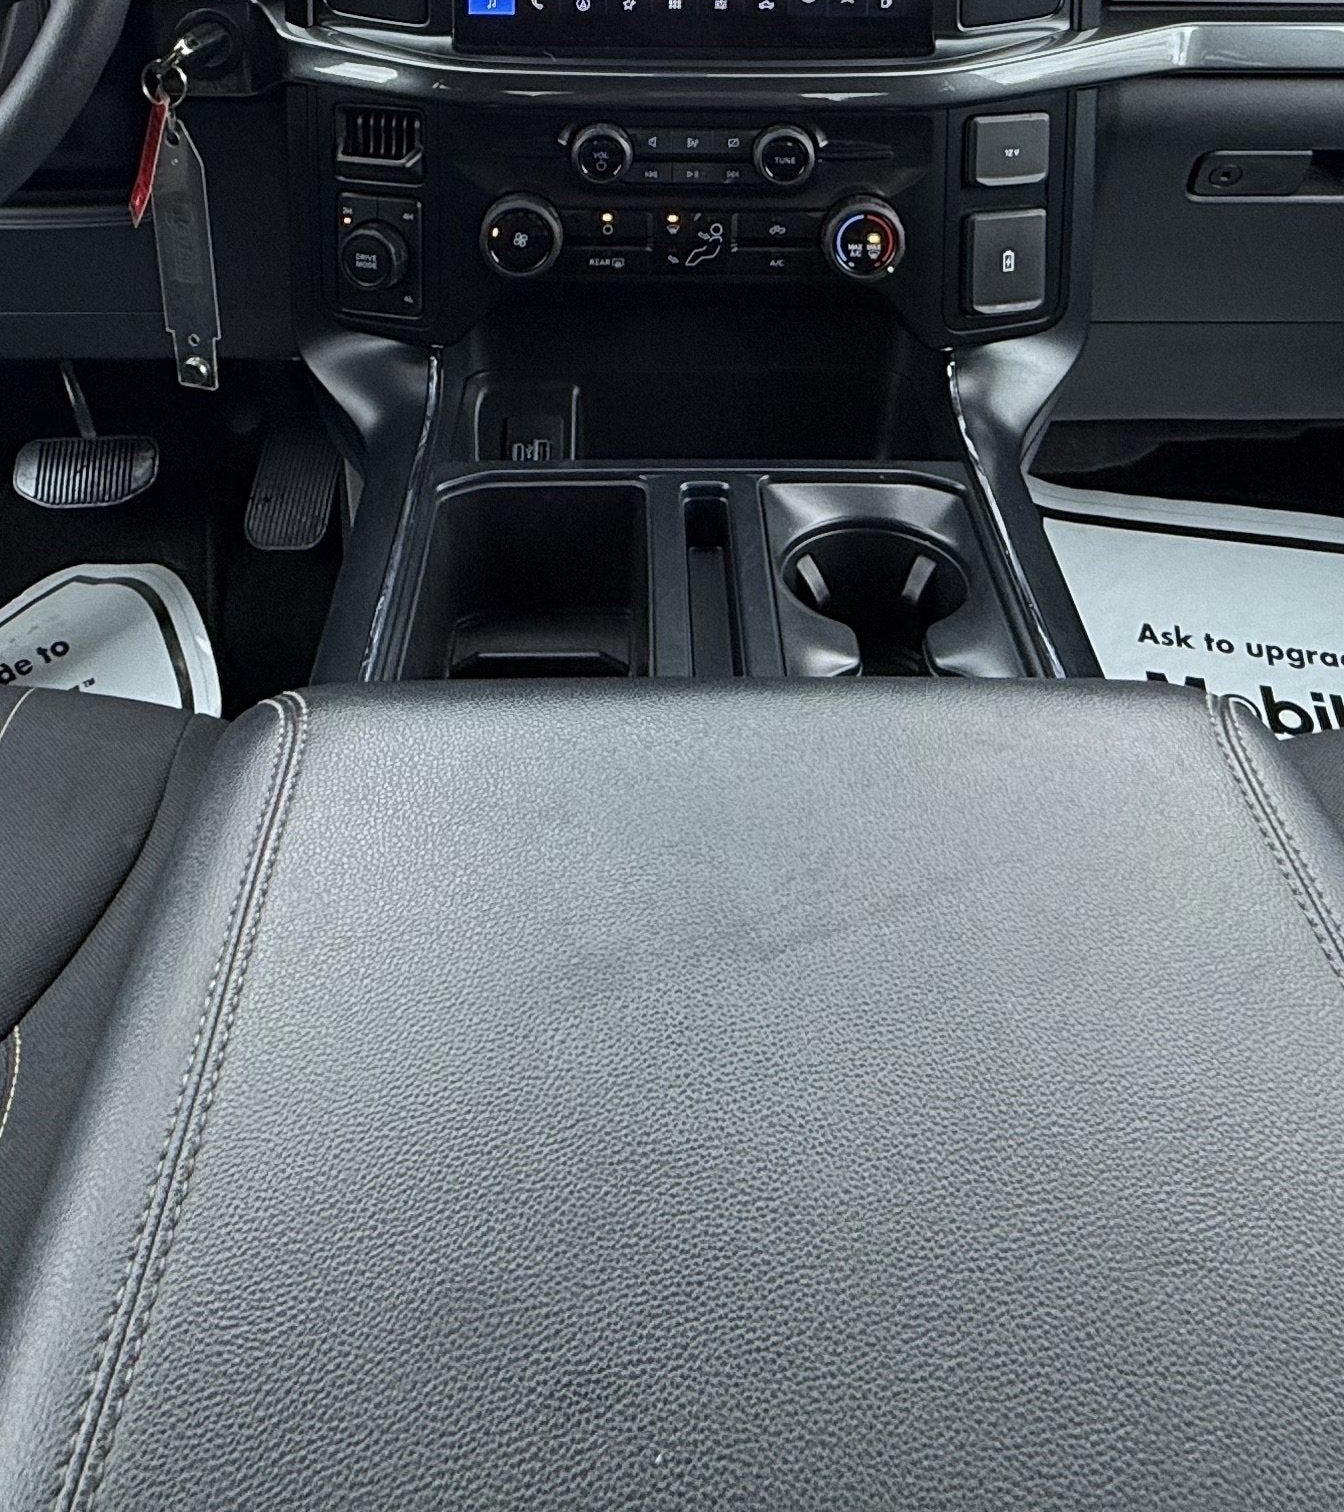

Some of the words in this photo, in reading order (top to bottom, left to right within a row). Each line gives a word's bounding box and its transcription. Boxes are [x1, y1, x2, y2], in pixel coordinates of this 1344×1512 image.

[774, 157, 797, 165] TUNE
[589, 258, 610, 267] REAR
[769, 259, 785, 267] A/C
[1137, 622, 1196, 649] Ask
[1204, 633, 1235, 654] to
[36, 640, 71, 664] to
